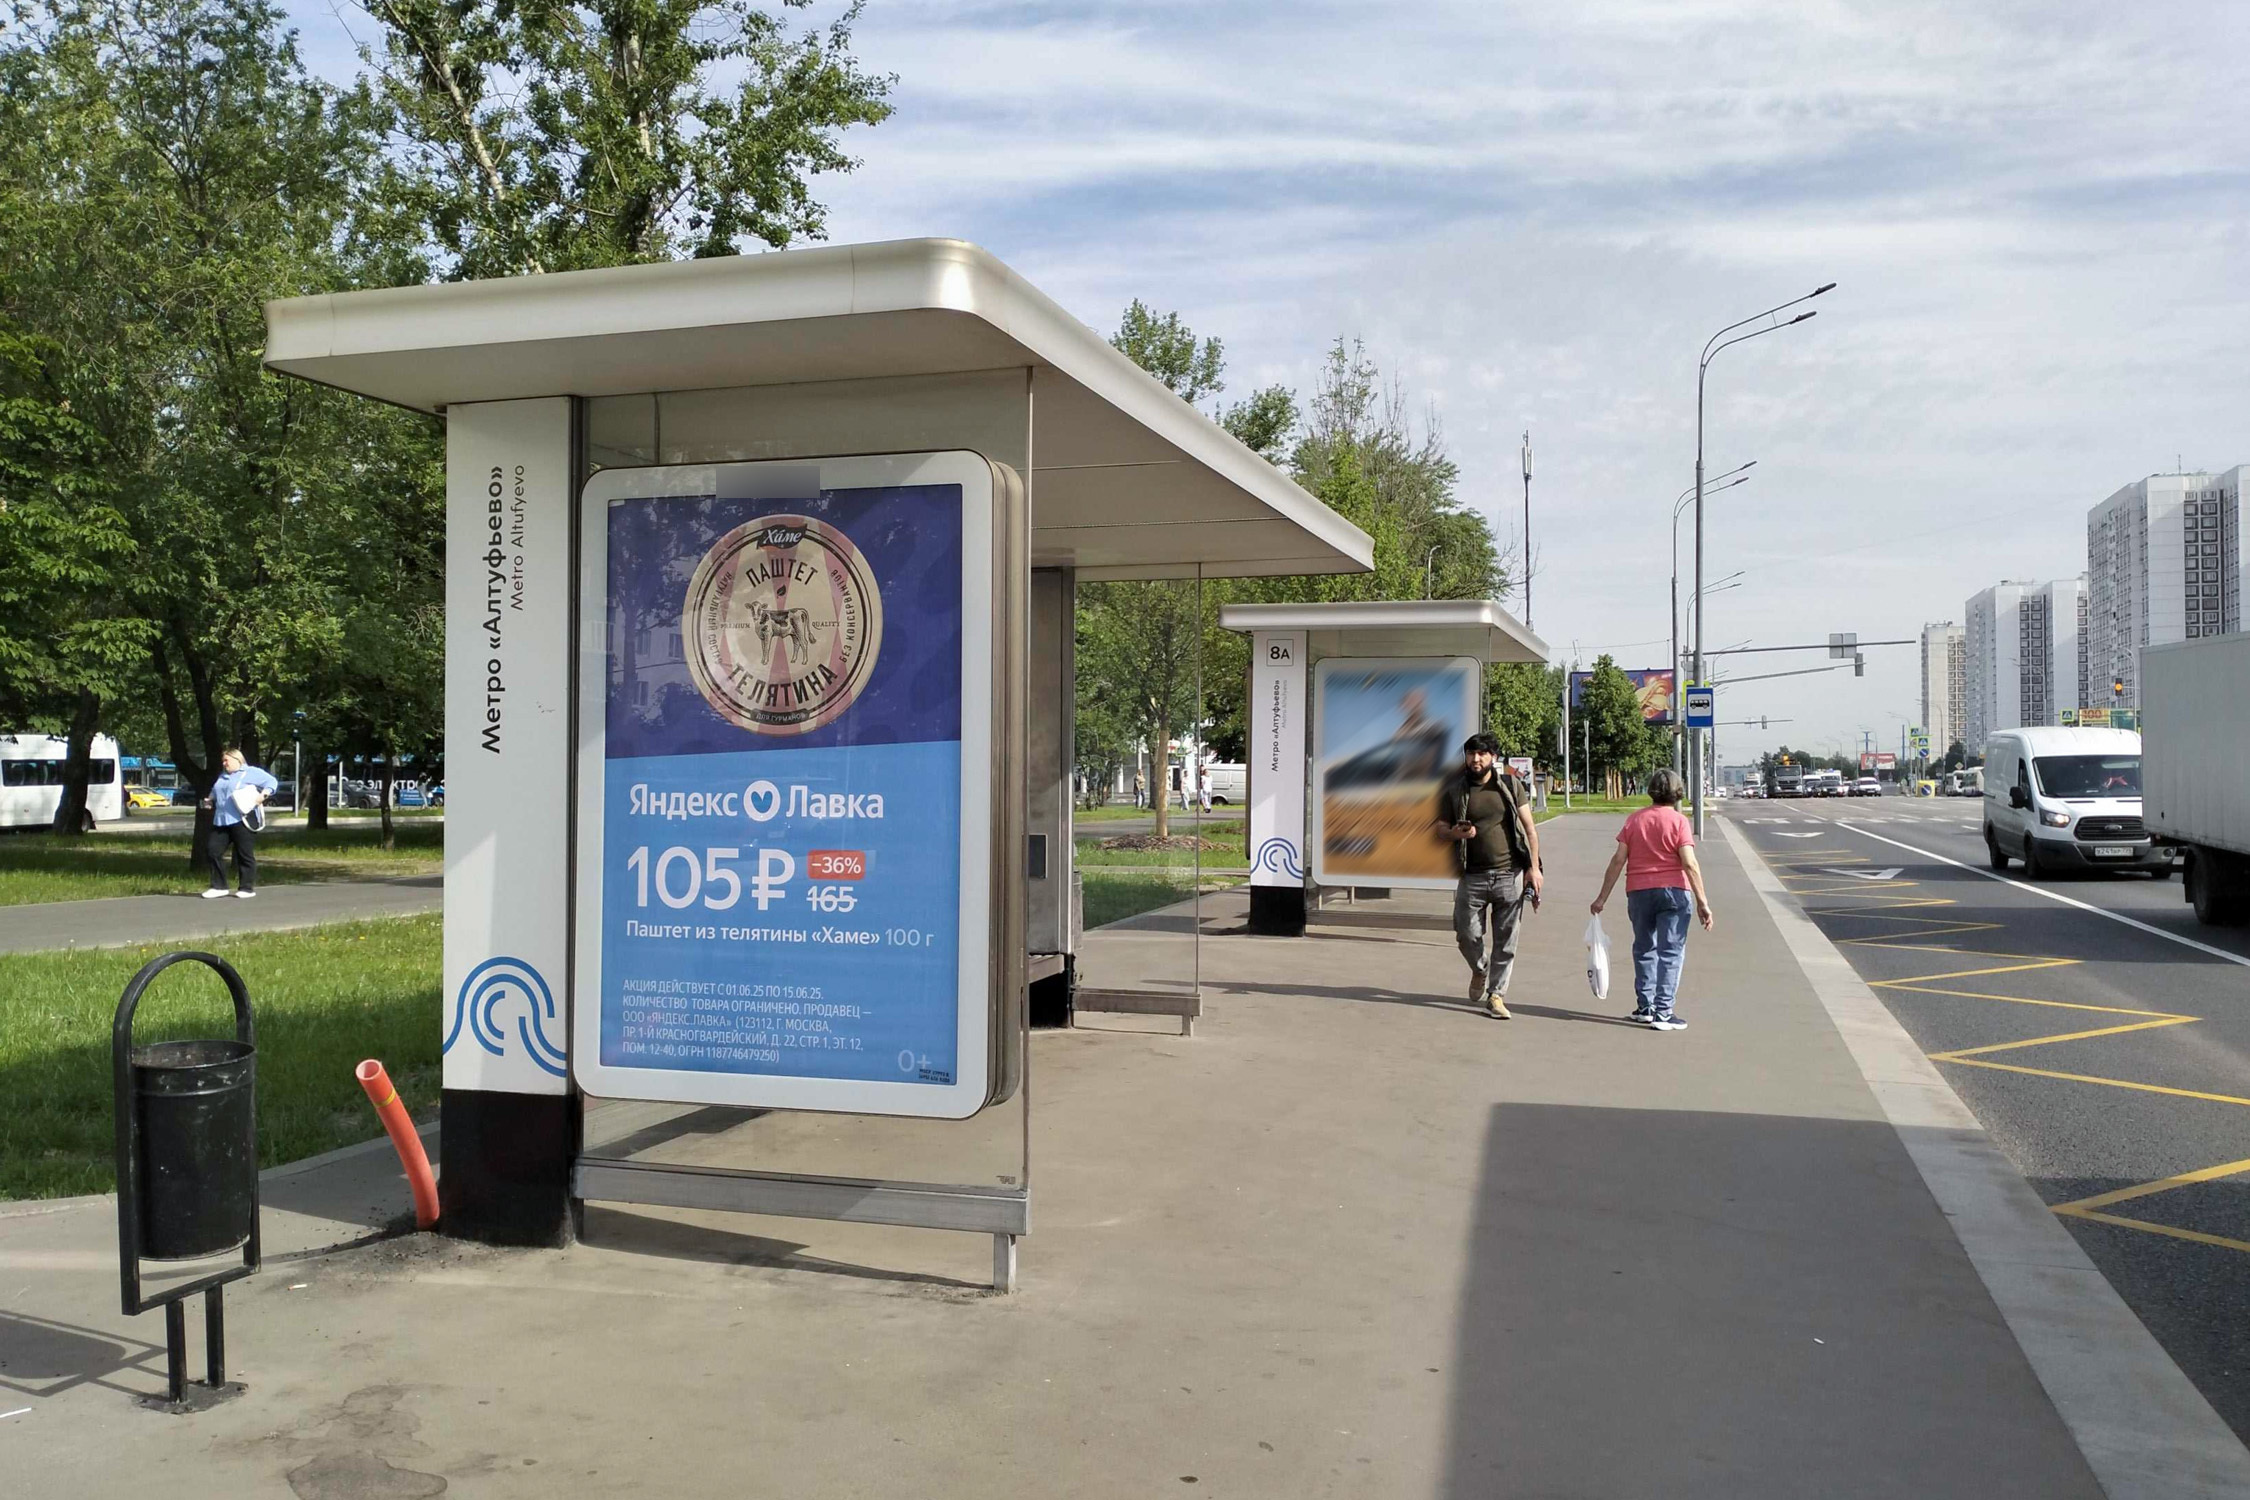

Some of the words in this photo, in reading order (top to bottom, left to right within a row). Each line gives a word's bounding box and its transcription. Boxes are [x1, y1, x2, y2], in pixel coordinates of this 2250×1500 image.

[510, 465, 527, 548] Altufyevo
[482, 466, 506, 650] «Алтуфьево»
[745, 557, 819, 588] ПАШТЕТ
[510, 555, 524, 611] Metro
[831, 569, 856, 641] КОНСЕРВАНТОВ
[811, 620, 841, 630] QUALITY
[839, 644, 853, 664] БЕЗ
[726, 662, 839, 708] ТЕЛЯТИНА
[482, 658, 505, 754] Метро
[1272, 680, 1281, 739] «Алтуфьево»
[1272, 741, 1280, 772] Метро
[629, 783, 738, 820] Яндекс
[786, 785, 884, 818] Лавка
[806, 886, 857, 912] 165
[626, 920, 691, 939] Паштет
[696, 925, 716, 939] из
[721, 926, 807, 943] телятины
[812, 927, 880, 945] «Хаме»
[885, 928, 921, 946] 100
[926, 933, 934, 947] г
[623, 979, 657, 993] АКЦИЯ
[658, 980, 716, 995] ДЕЙСТВУЕТ
[717, 983, 725, 996] С
[726, 984, 764, 997] 01.06.25
[765, 985, 780, 998] ПО
[783, 987, 824, 1000] 15.06.25.
[623, 995, 688, 1009] КОЛИЧЕСТВО
[692, 998, 730, 1012] ТОВАРА
[731, 1000, 801, 1015] ОГРАНИЧЕНО.
[803, 1003, 860, 1019] ПРОДАВЕЦ
[623, 1011, 645, 1023] ООО
[735, 1015, 775, 1030] (123112,
[786, 1019, 832, 1034] МОСКВА,
[623, 1026, 636, 1038] ПР.
[638, 1025, 655, 1039] 1-Й
[656, 1027, 769, 1046] КРАСНОГВАРДЕЙСКИЙ,
[771, 1033, 782, 1047] Д.
[784, 1034, 797, 1048] 22,
[799, 1035, 821, 1048] СТР.
[832, 1037, 847, 1050] ЭТ.
[849, 1038, 864, 1051] 12,
[623, 1042, 647, 1054] ПОМ.
[650, 1043, 676, 1056] 12-40,
[678, 1045, 704, 1058] ОГРН
[706, 1047, 780, 1064] 1187746479250)
[898, 1049, 932, 1072] 0+
